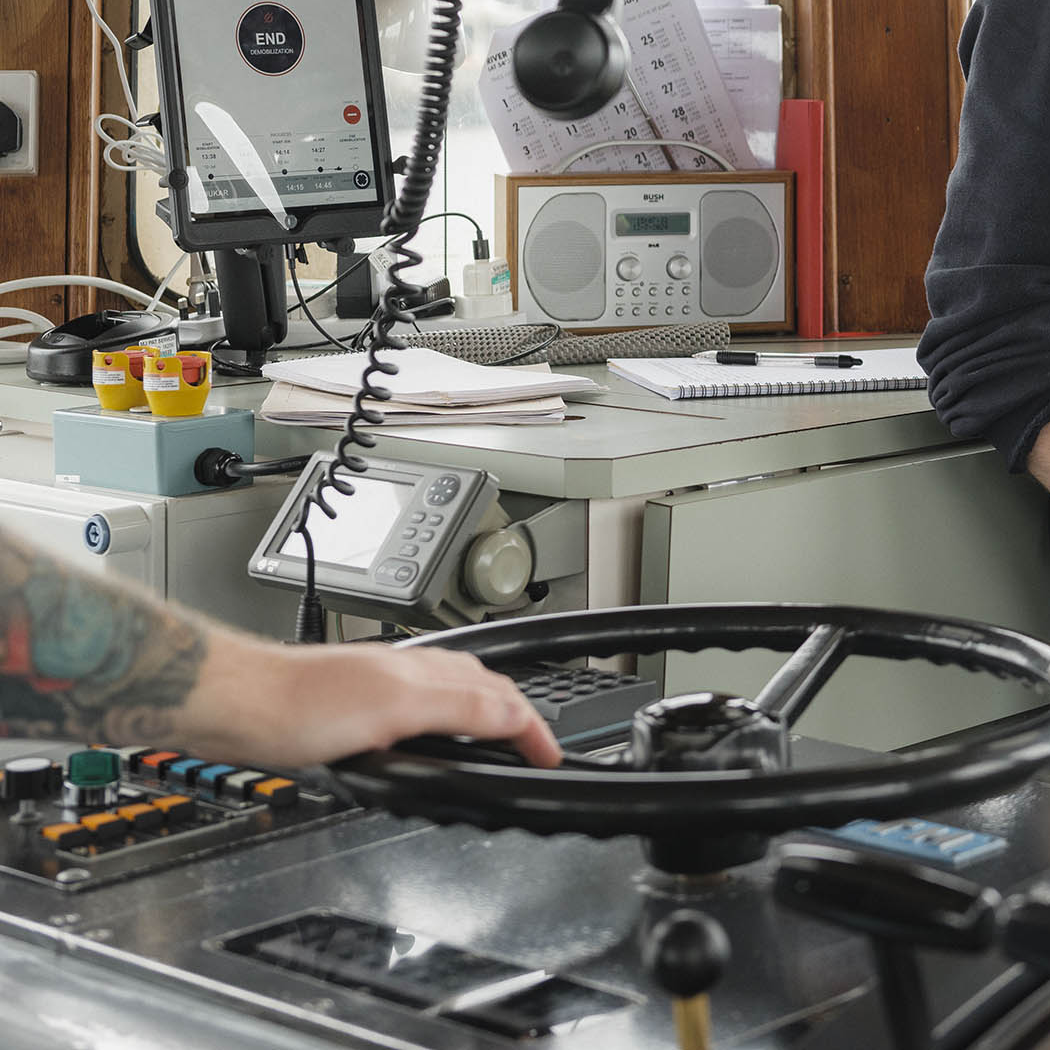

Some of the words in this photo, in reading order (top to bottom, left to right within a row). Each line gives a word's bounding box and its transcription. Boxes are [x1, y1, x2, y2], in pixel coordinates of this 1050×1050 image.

[255, 33, 286, 45] END
[641, 33, 654, 45] 25
[651, 58, 664, 70] 26
[662, 82, 673, 94] 27
[614, 102, 626, 115] 19
[672, 106, 685, 118] 28
[513, 122, 520, 132] 2
[566, 124, 577, 136] 11
[624, 127, 637, 140] 20
[682, 130, 695, 142] 29
[523, 146, 530, 156] 3
[635, 151, 648, 165] 21
[694, 155, 707, 168] 30
